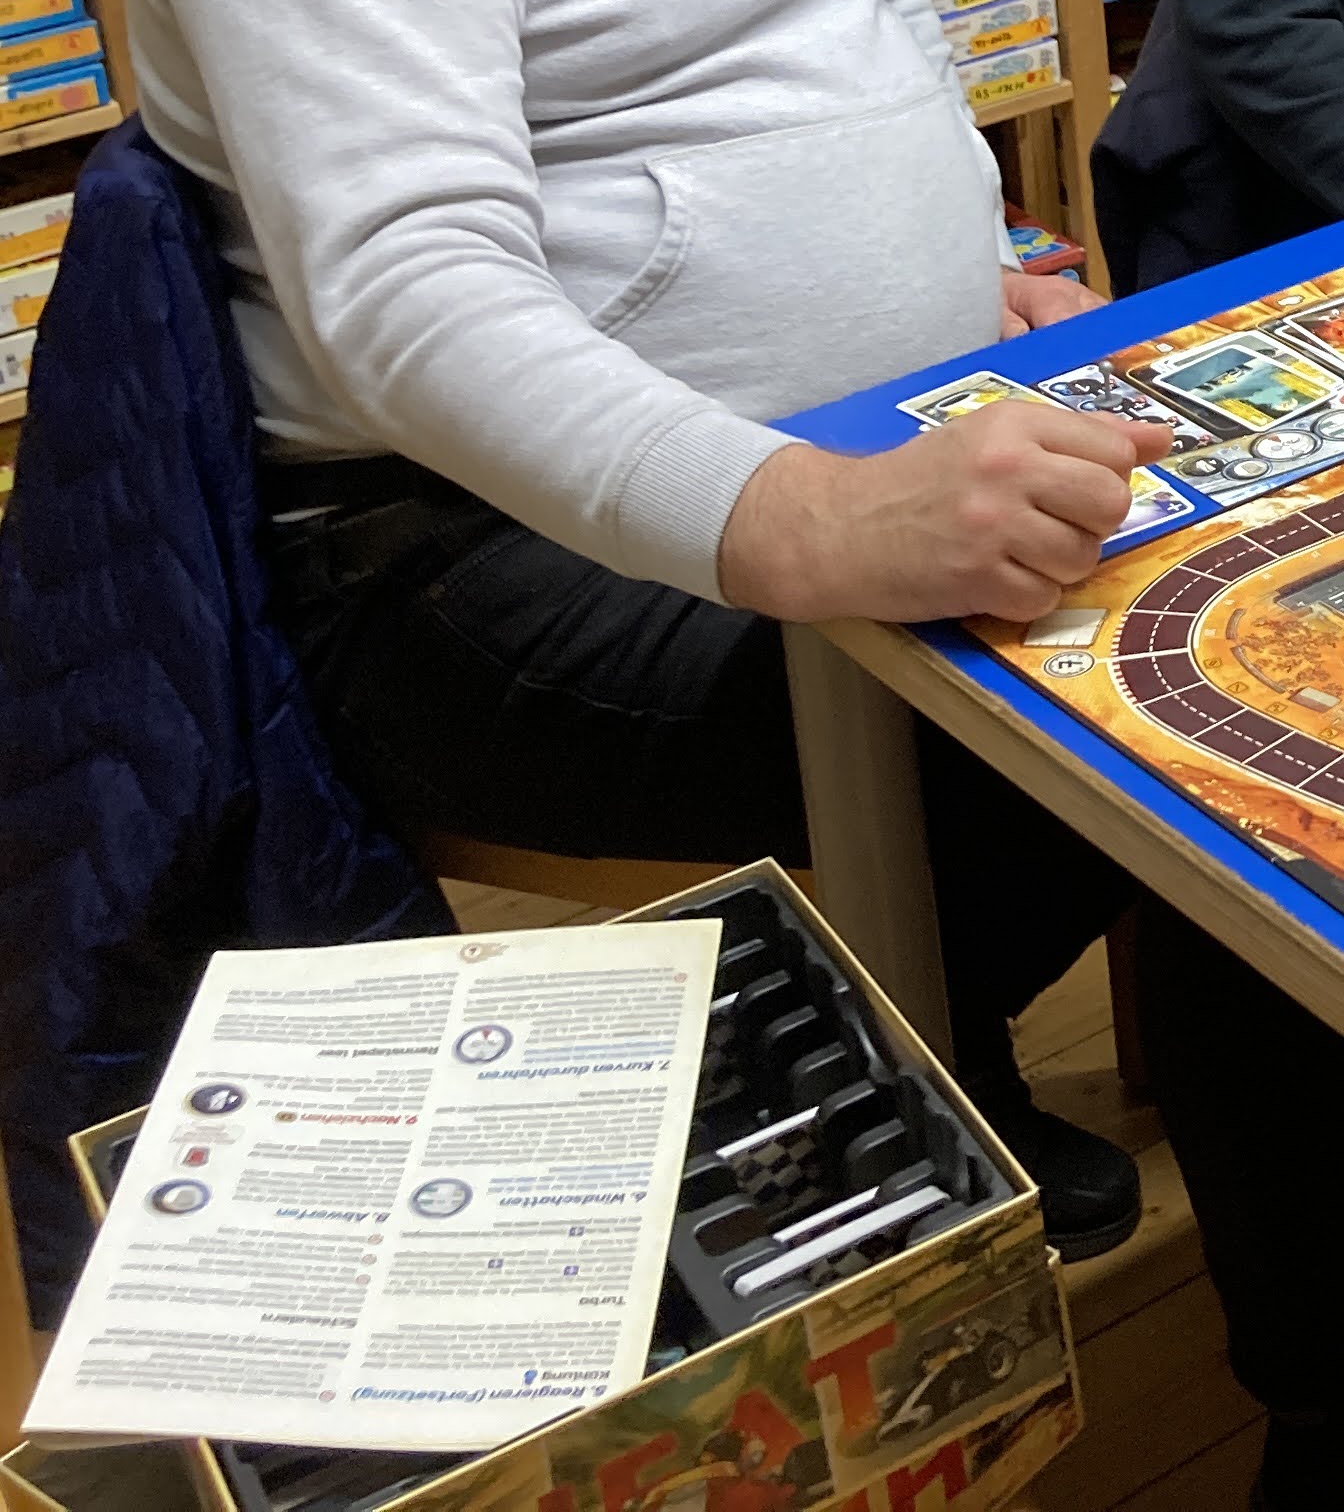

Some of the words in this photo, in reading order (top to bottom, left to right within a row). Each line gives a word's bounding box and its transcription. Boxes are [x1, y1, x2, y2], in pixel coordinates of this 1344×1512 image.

[477, 1065, 590, 1081] durchfahren
[592, 1060, 655, 1075] Kurven
[300, 1112, 401, 1126] Nachziehen
[499, 1193, 626, 1209] Windschatten
[275, 1208, 369, 1223] Abwerfen
[579, 1296, 626, 1307] Turbo
[350, 1386, 487, 1403] (Fortsetzung)
[488, 1385, 586, 1401] Reagieren
